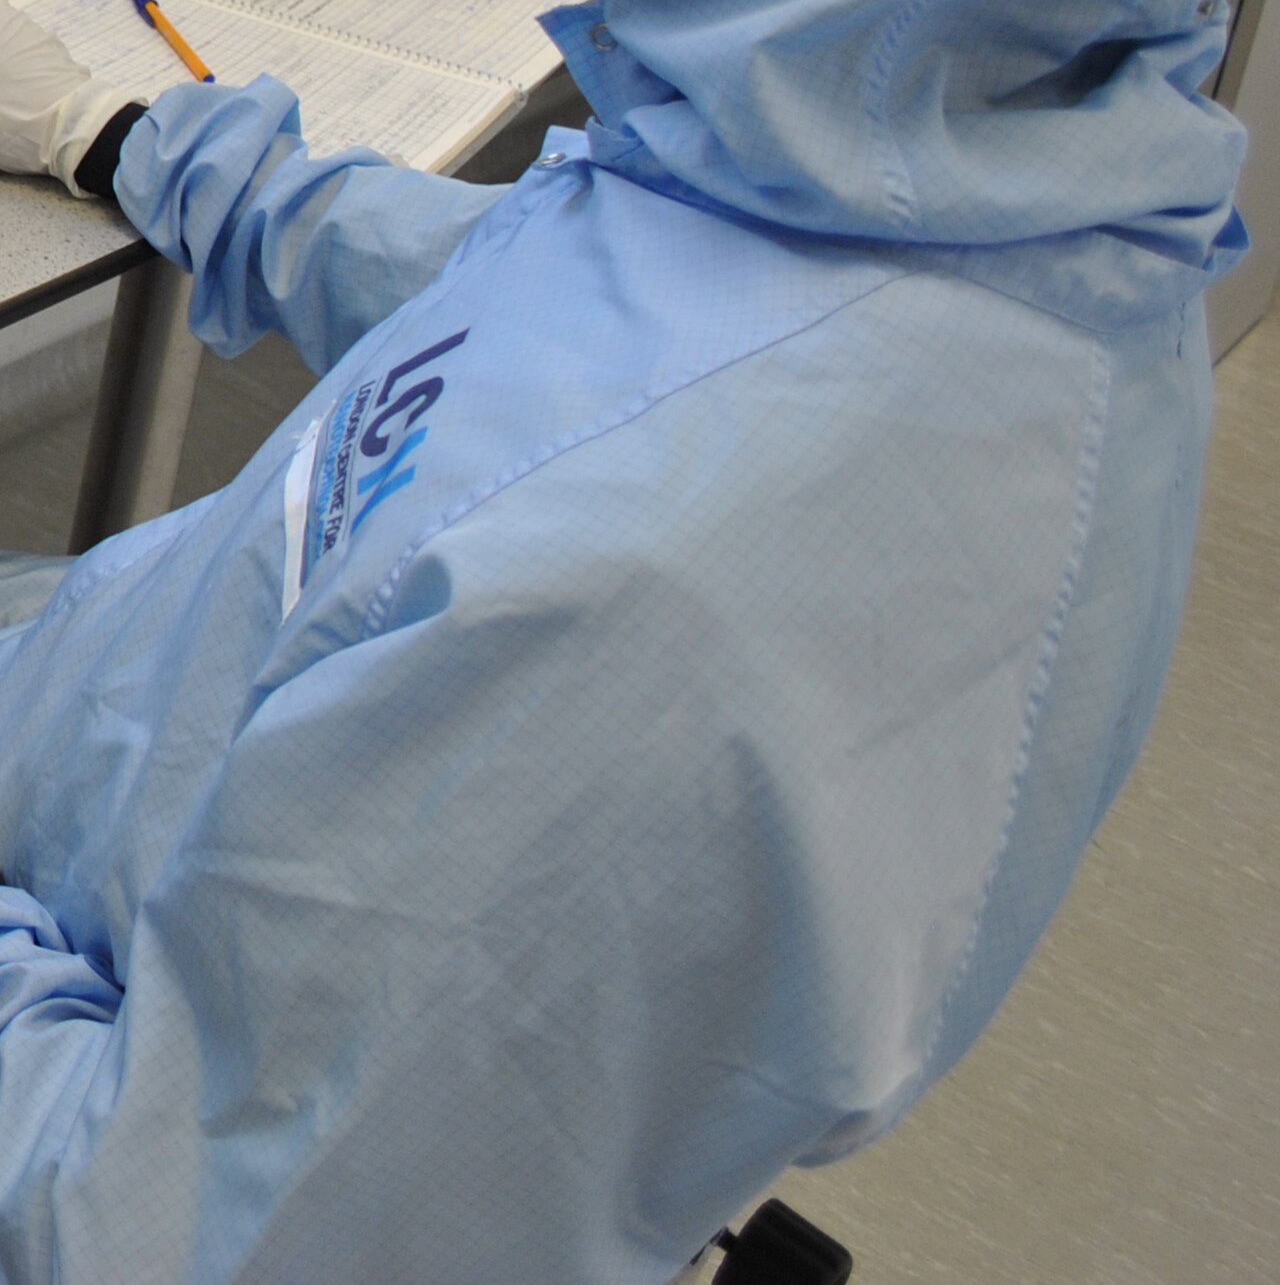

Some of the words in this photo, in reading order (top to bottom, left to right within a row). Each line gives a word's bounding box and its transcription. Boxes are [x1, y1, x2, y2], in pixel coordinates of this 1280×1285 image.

[342, 379, 377, 445] LONDON
[350, 326, 471, 538] LCN
[328, 444, 353, 515] CENTRE
[322, 514, 345, 555] FOR
